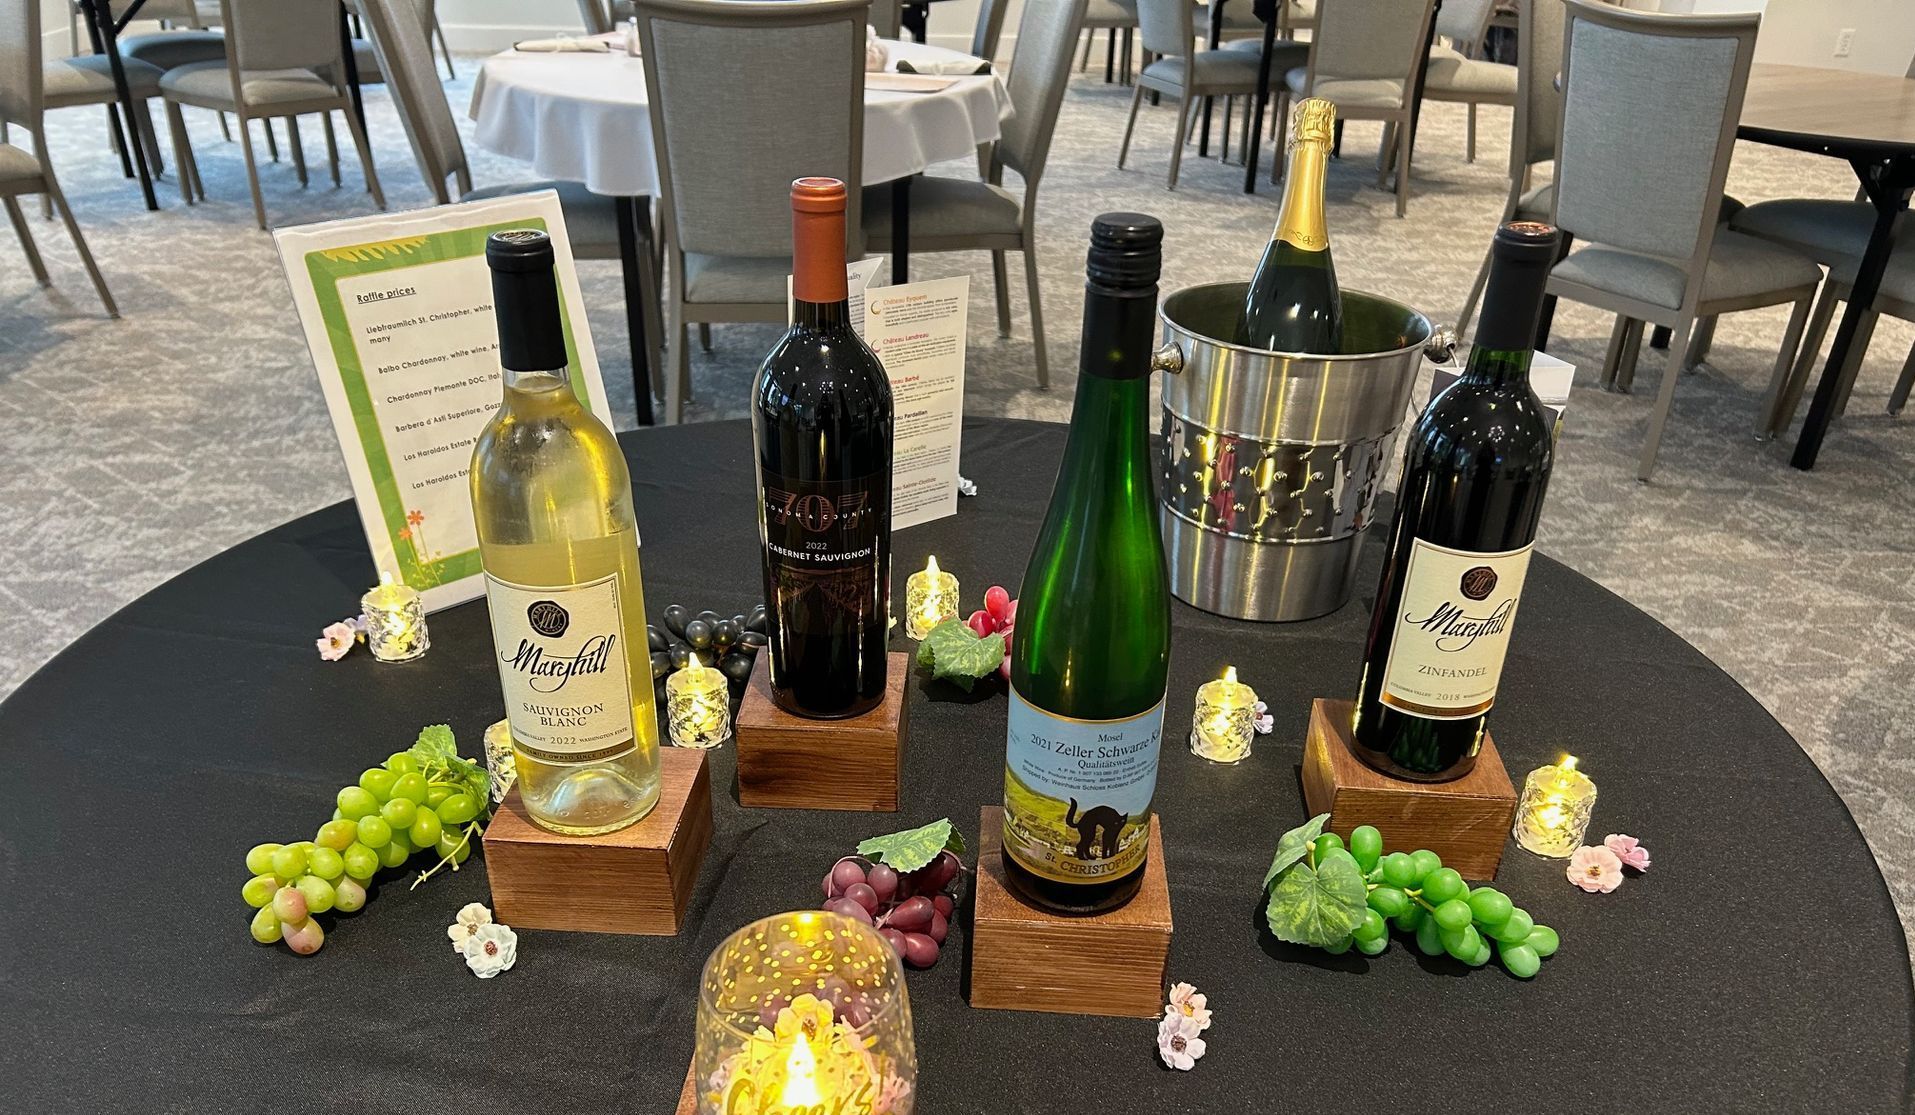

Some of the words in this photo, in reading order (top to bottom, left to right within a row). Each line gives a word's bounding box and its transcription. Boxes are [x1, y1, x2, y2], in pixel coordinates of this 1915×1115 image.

[356, 291, 384, 303] Raffle
[386, 287, 416, 300] prices
[418, 316, 428, 324] St.
[473, 304, 493, 313] white
[369, 336, 391, 345] many
[378, 365, 400, 374] Balbo
[401, 355, 449, 369] Chardonnay,
[450, 350, 469, 359] white
[387, 389, 432, 404] Chardonnay
[434, 381, 467, 393] Piemonte
[487, 372, 501, 380] Ital
[395, 420, 425, 433] Barbera
[417, 445, 449, 457] Haroldos
[450, 439, 472, 449] Estate
[425, 473, 457, 486] Haroldos
[768, 542, 811, 561] CABERNET
[814, 547, 871, 562] SAUVIGNON
[805, 541, 828, 550] 2022
[1404, 598, 1517, 653] Maryhill
[501, 634, 616, 693] Maryhill
[1418, 664, 1488, 679] ZINFANDEL
[1435, 692, 1460, 701] 2018
[523, 702, 605, 718] SAUVIGNON
[540, 717, 588, 727] BLANC
[550, 736, 577, 745] 2022
[1097, 732, 1123, 743] Mosel
[1030, 733, 1051, 750] 2021
[1055, 741, 1094, 759] Zeller
[1098, 739, 1150, 759] Schwarze
[1078, 757, 1135, 769] Qualitätswein
[1045, 852, 1057, 864] St.
[1060, 844, 1141, 875] CHRISTOPHER
